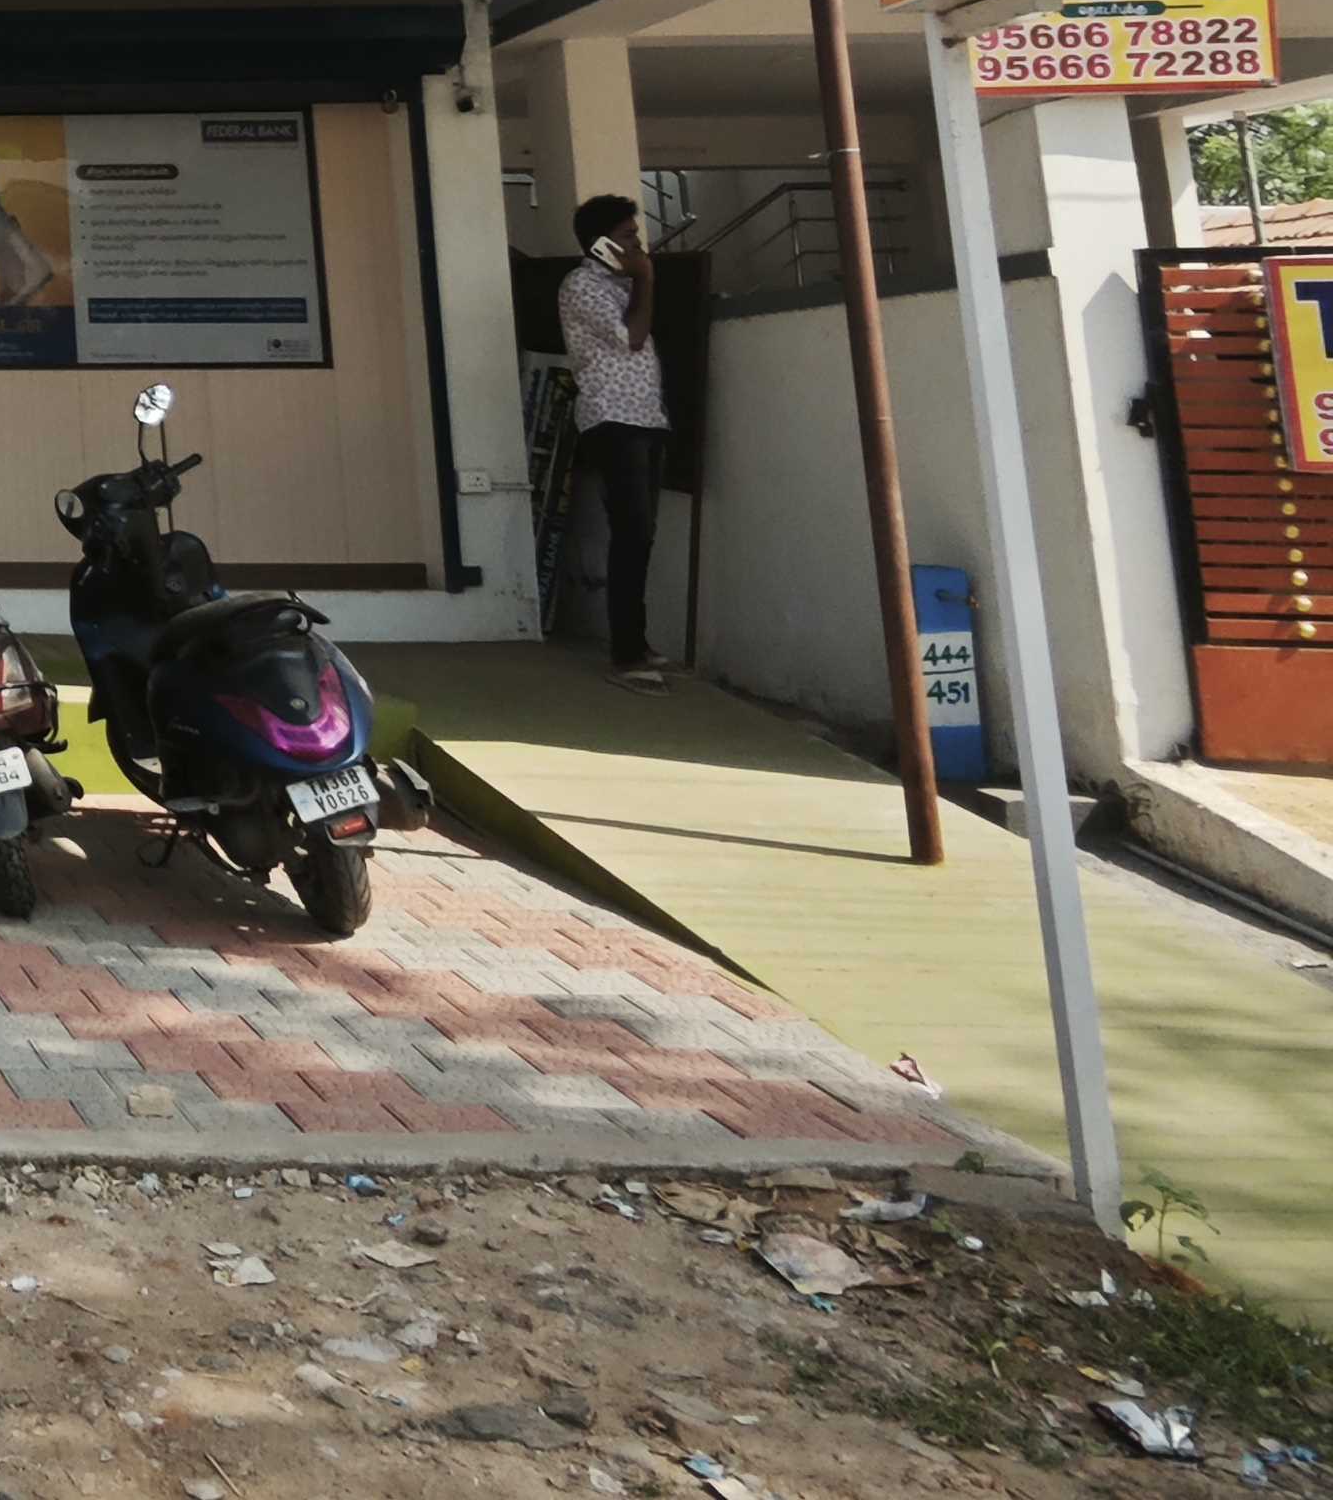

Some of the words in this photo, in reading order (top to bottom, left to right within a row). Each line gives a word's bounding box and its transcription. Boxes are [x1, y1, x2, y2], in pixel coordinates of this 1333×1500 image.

[976, 22, 1110, 52] 95666
[1124, 17, 1258, 47] 78822
[977, 53, 1111, 81] 95666
[1126, 49, 1261, 78] 72288
[206, 125, 256, 138] FEDERAL
[258, 124, 295, 137] BANK
[922, 642, 971, 667] 444
[926, 679, 971, 705] 451
